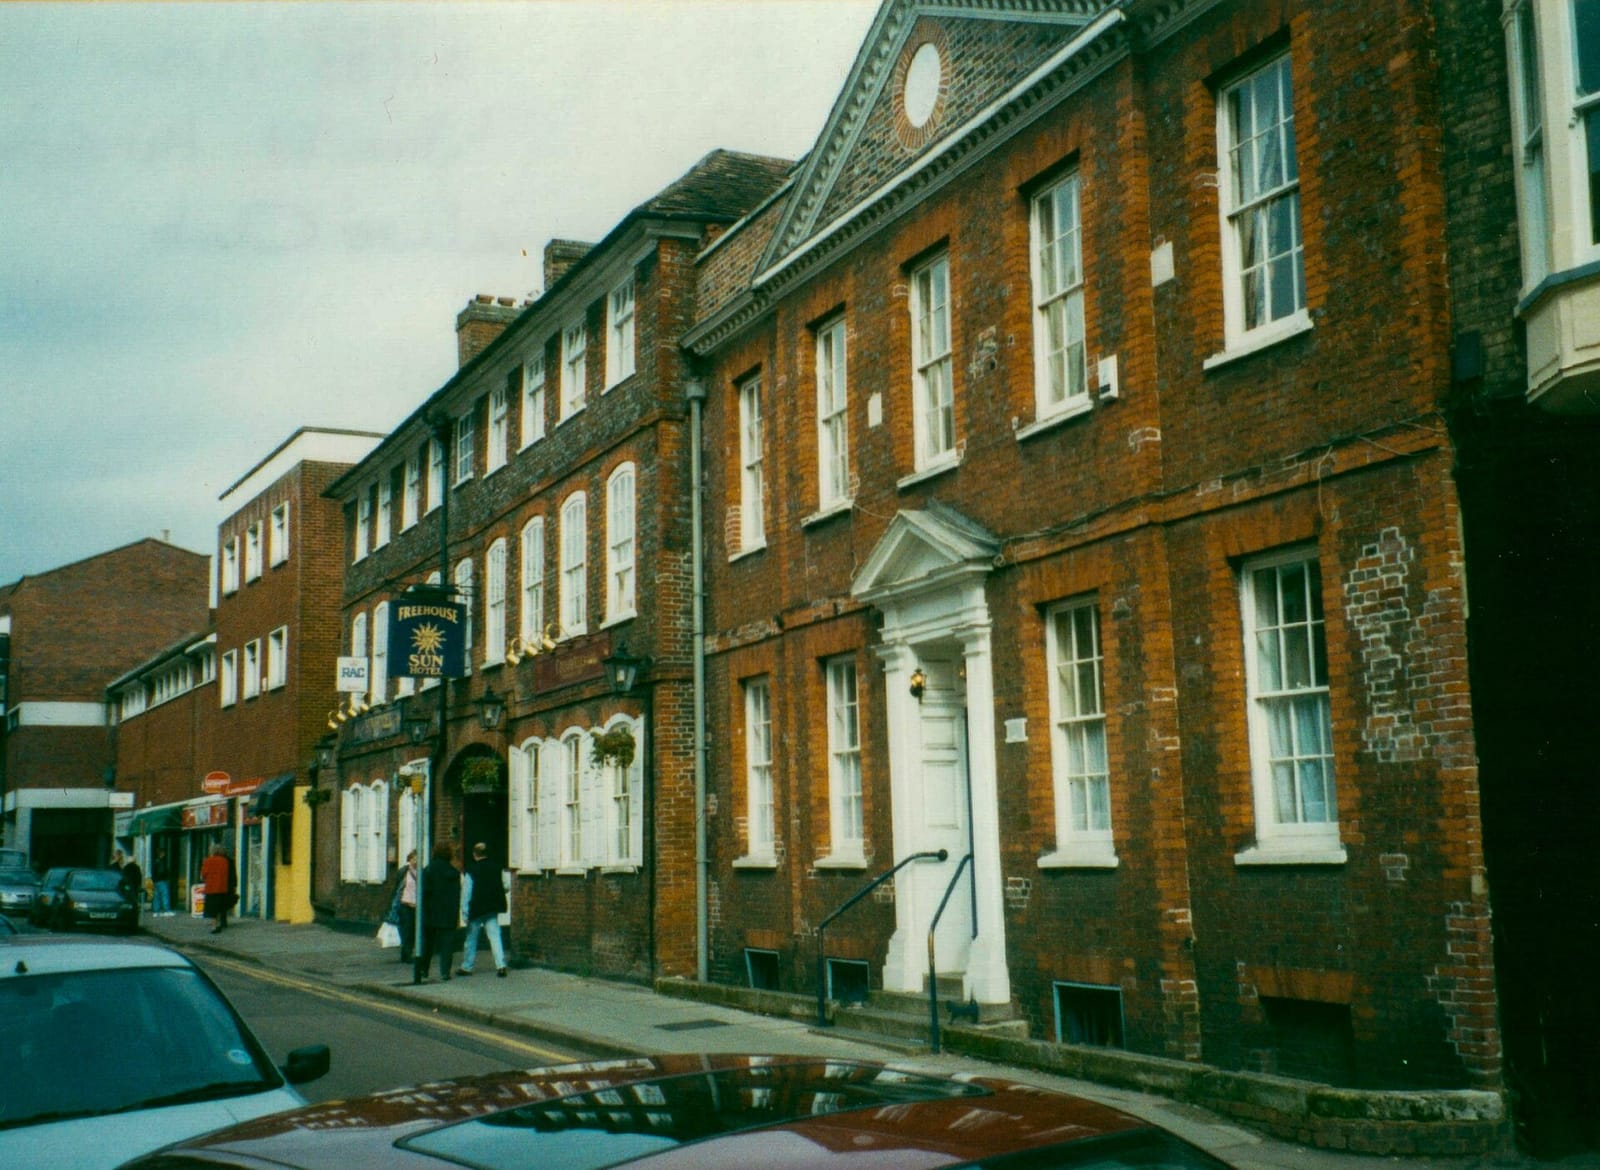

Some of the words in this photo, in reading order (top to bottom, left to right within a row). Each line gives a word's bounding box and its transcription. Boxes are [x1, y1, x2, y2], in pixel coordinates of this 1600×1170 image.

[398, 605, 459, 624] FREEHOUSE
[408, 655, 444, 667] SUN
[341, 667, 365, 678] RAC
[409, 666, 443, 675] HOTEL
